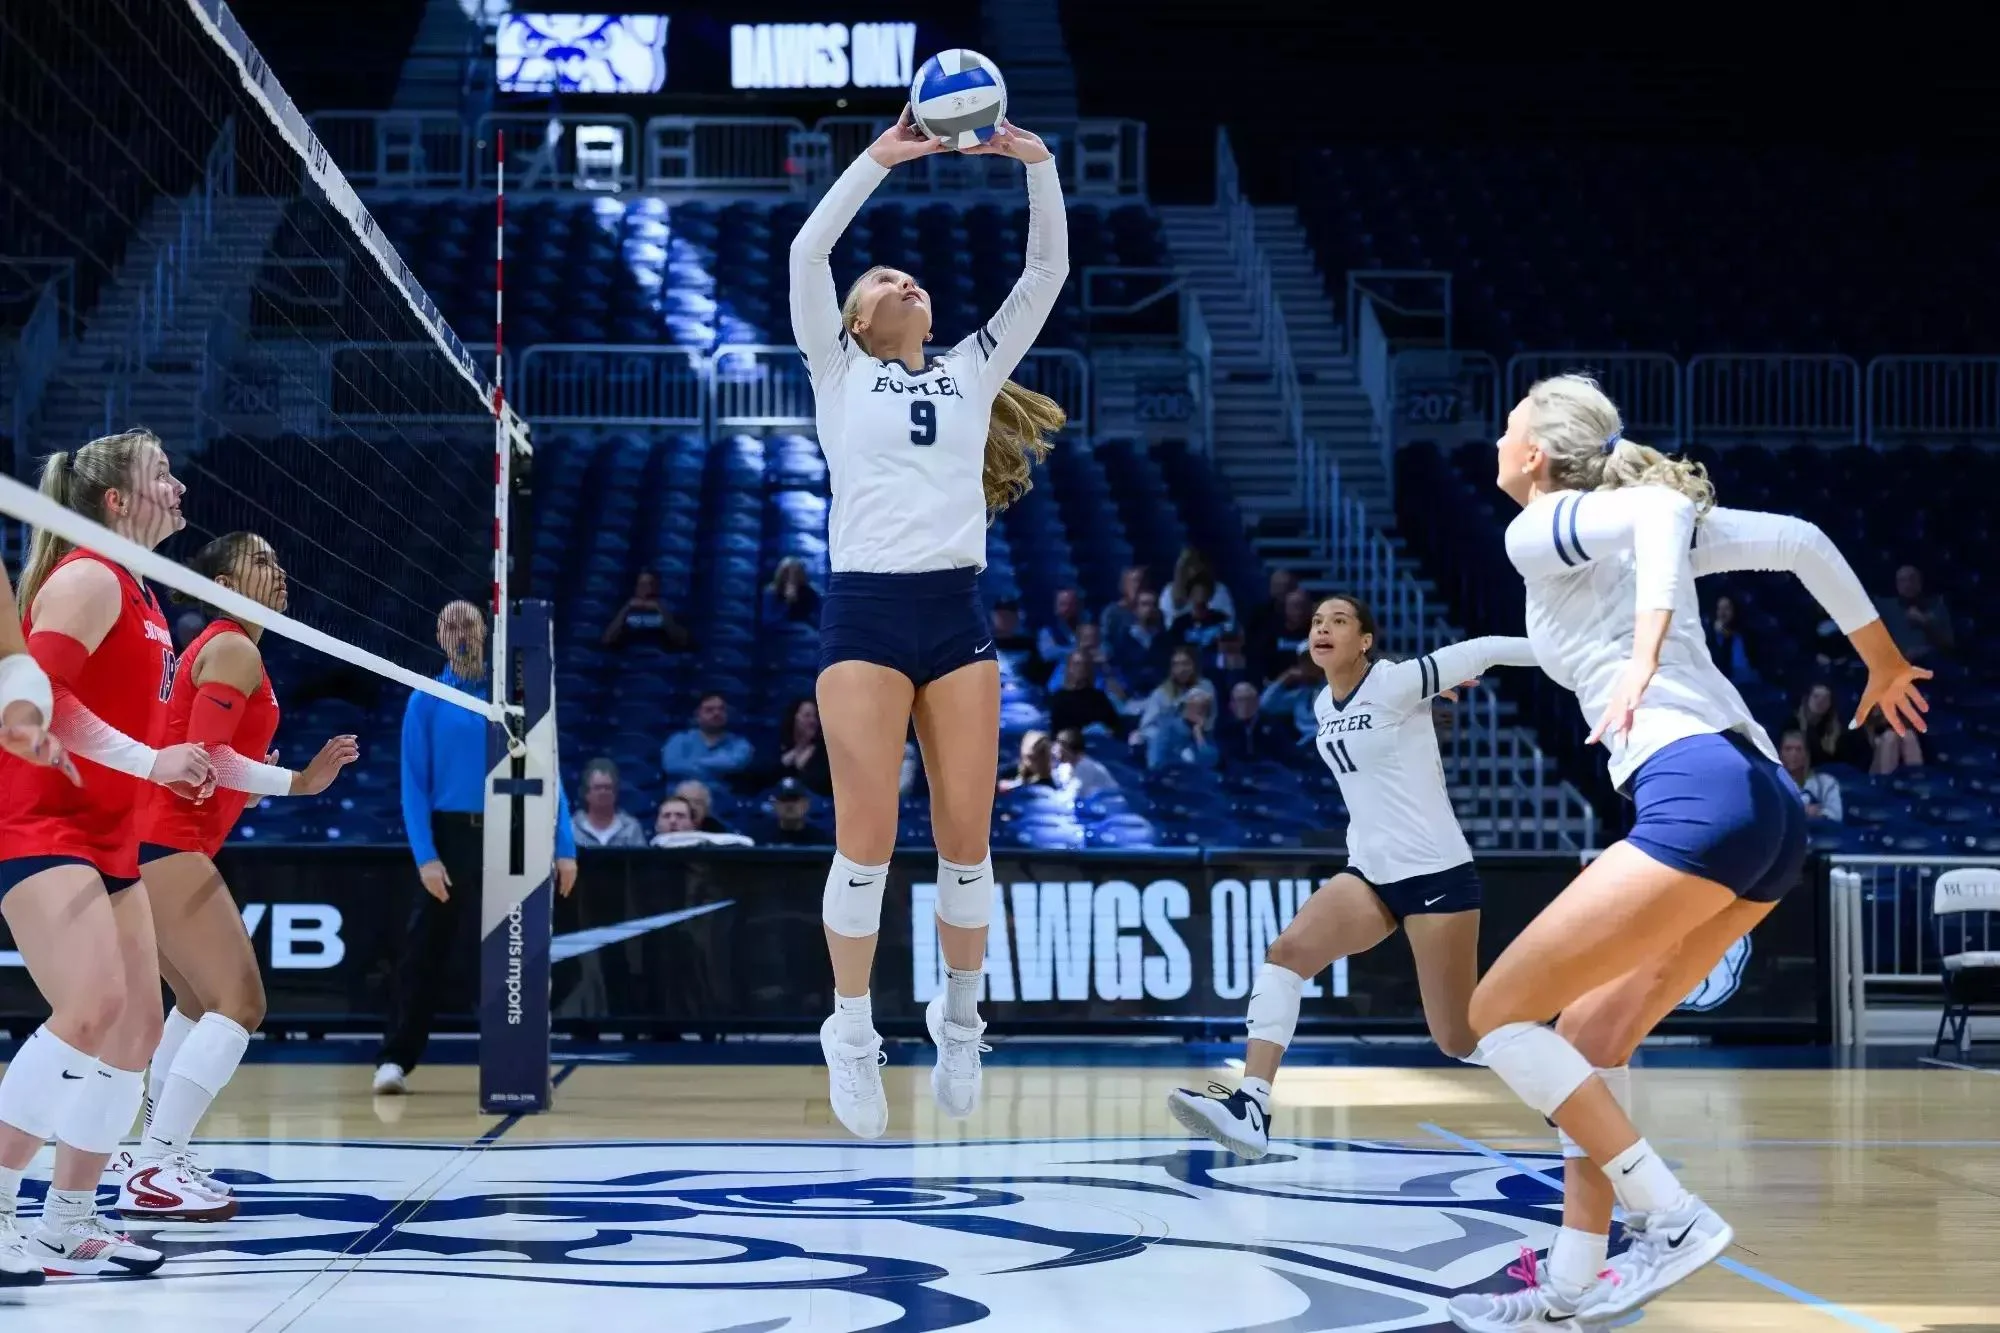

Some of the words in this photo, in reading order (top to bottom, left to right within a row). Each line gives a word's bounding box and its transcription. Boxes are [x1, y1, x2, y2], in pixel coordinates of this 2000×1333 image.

[910, 400, 937, 446] 9
[1408, 394, 1458, 420] 207
[1318, 713, 1373, 737] UTLER
[1325, 738, 1358, 774] 11
[508, 902, 524, 956] sports
[505, 957, 523, 1025] imports
